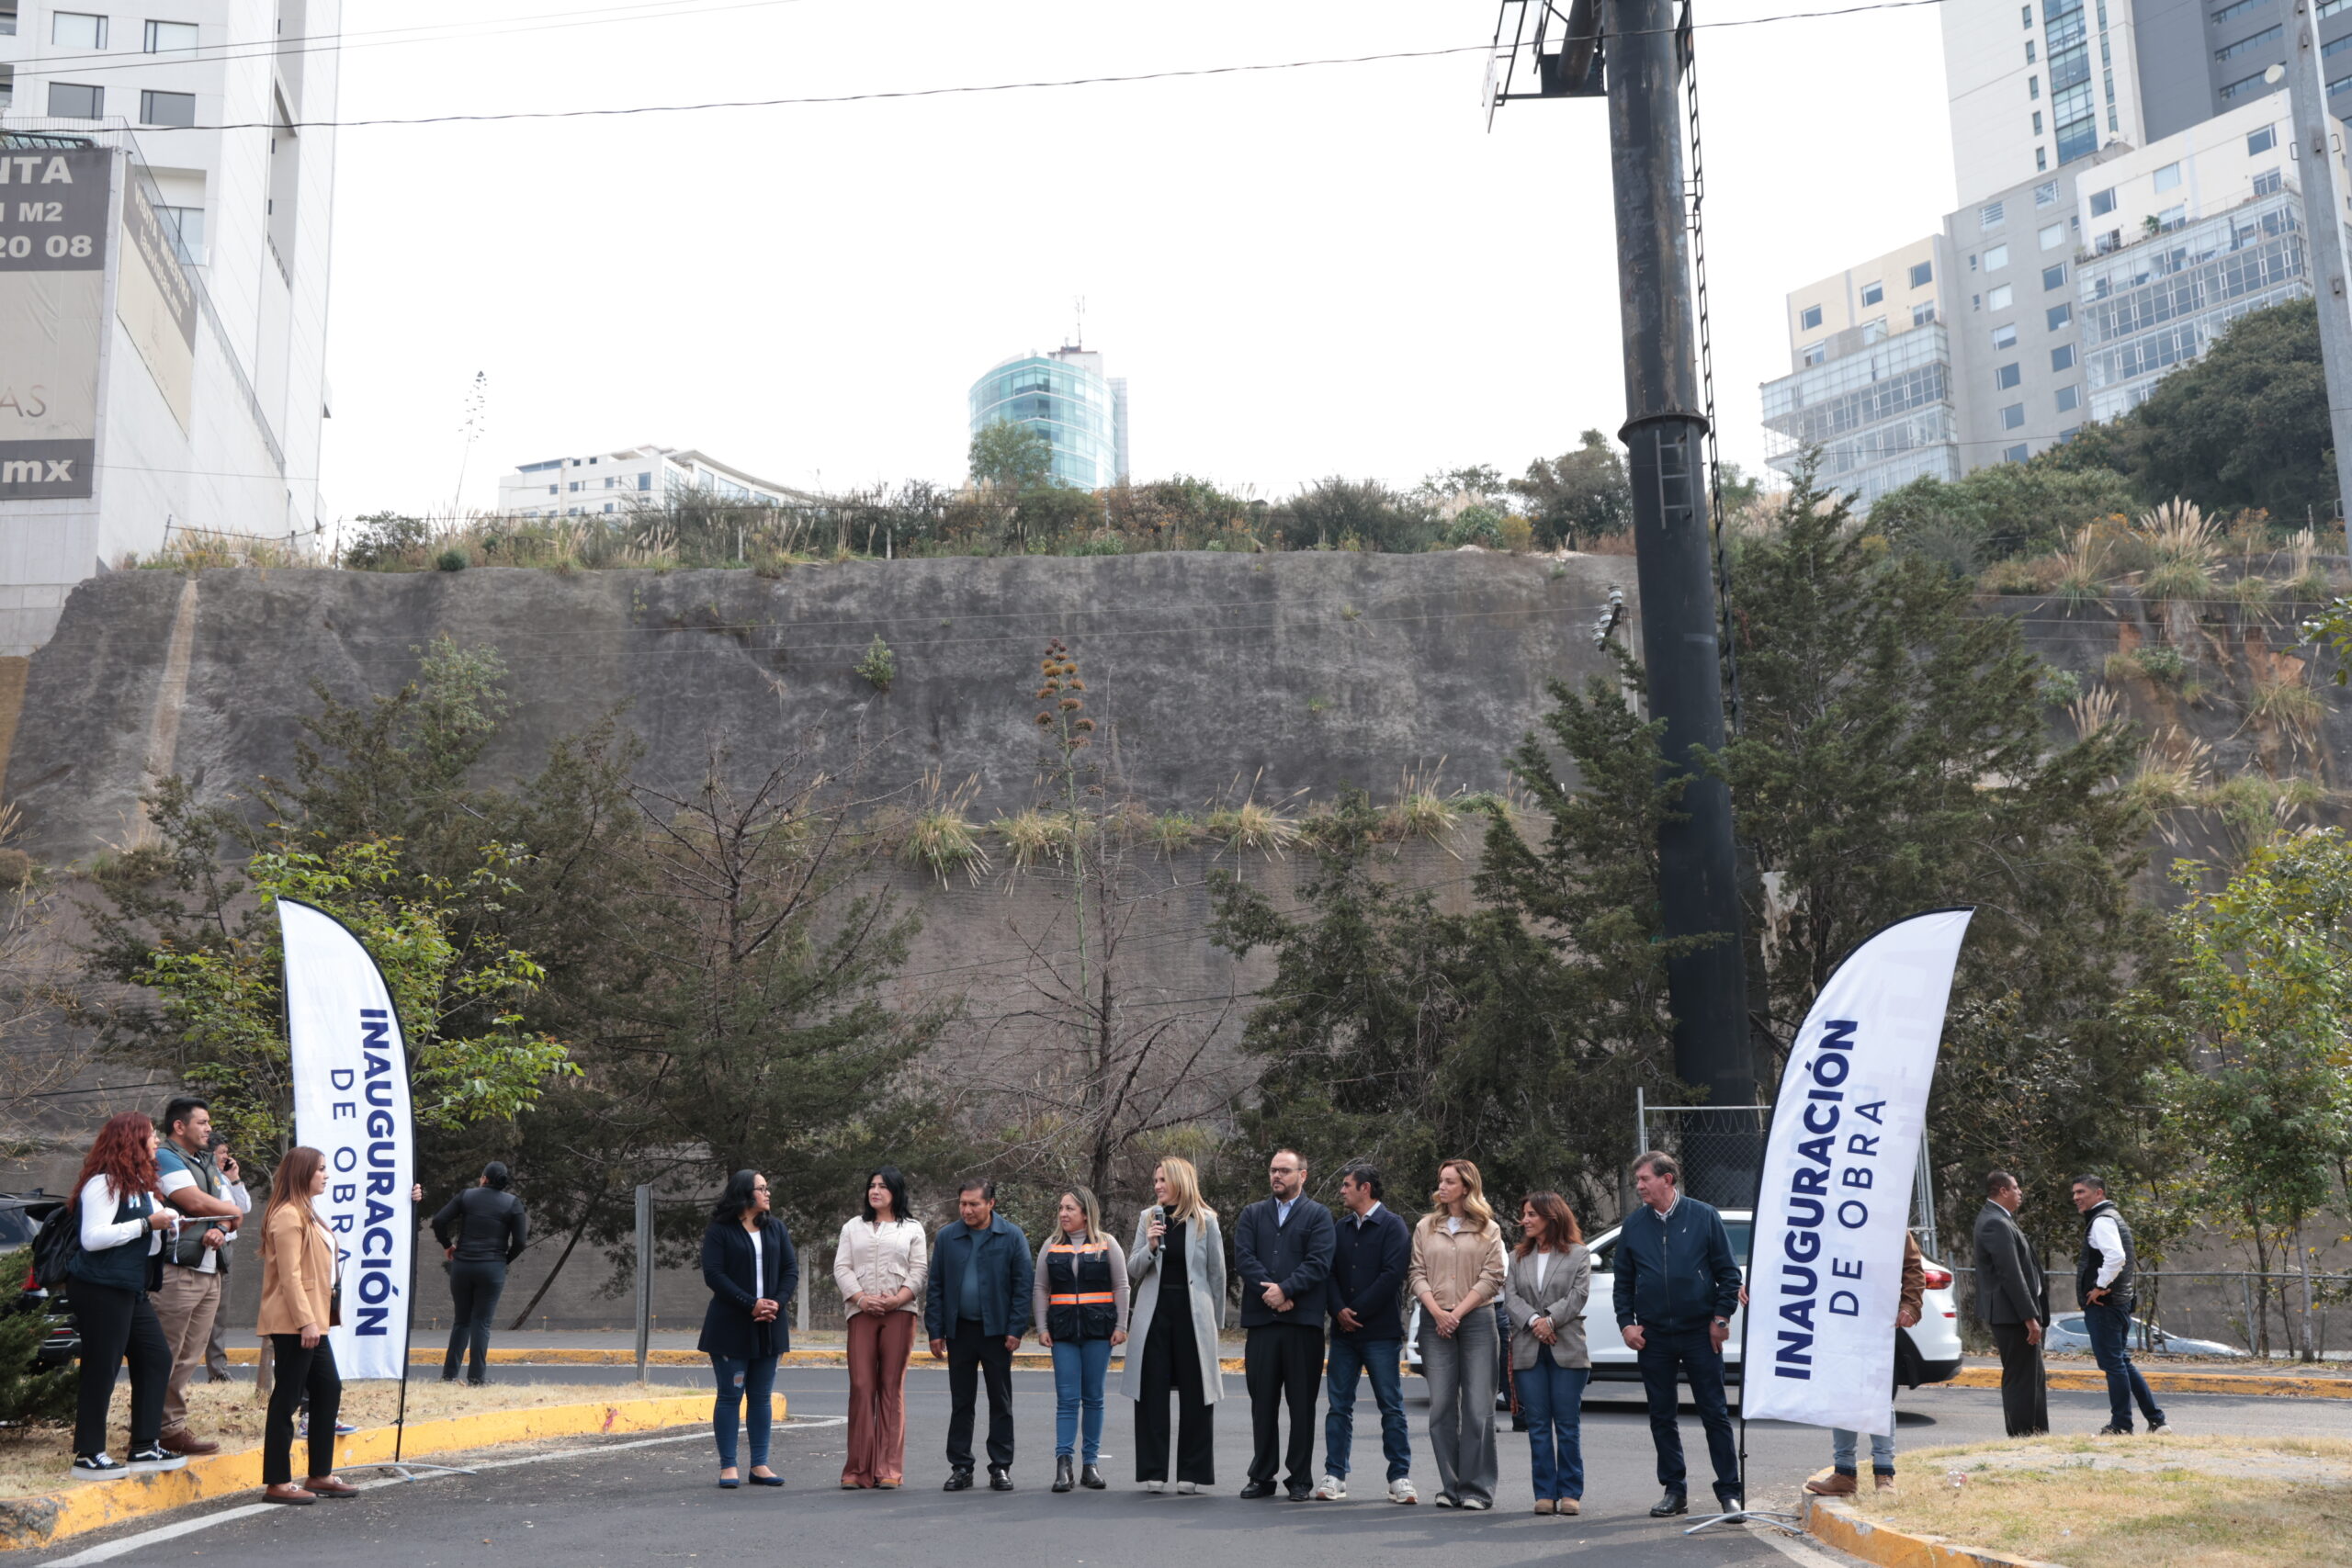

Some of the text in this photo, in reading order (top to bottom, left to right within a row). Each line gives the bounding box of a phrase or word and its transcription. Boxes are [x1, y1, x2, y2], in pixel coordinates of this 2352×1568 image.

[0, 234, 93, 257] 0 08
[18, 201, 63, 221] M2
[134, 181, 191, 308] VISITA MUESTRA
[0, 384, 46, 417] AS
[331, 1068, 356, 1120] DE
[355, 1009, 399, 1337] INAUGURACIÓN
[1774, 1020, 1859, 1381] INAUGURACIÓN
[1828, 1100, 1886, 1316] DE OBRA
